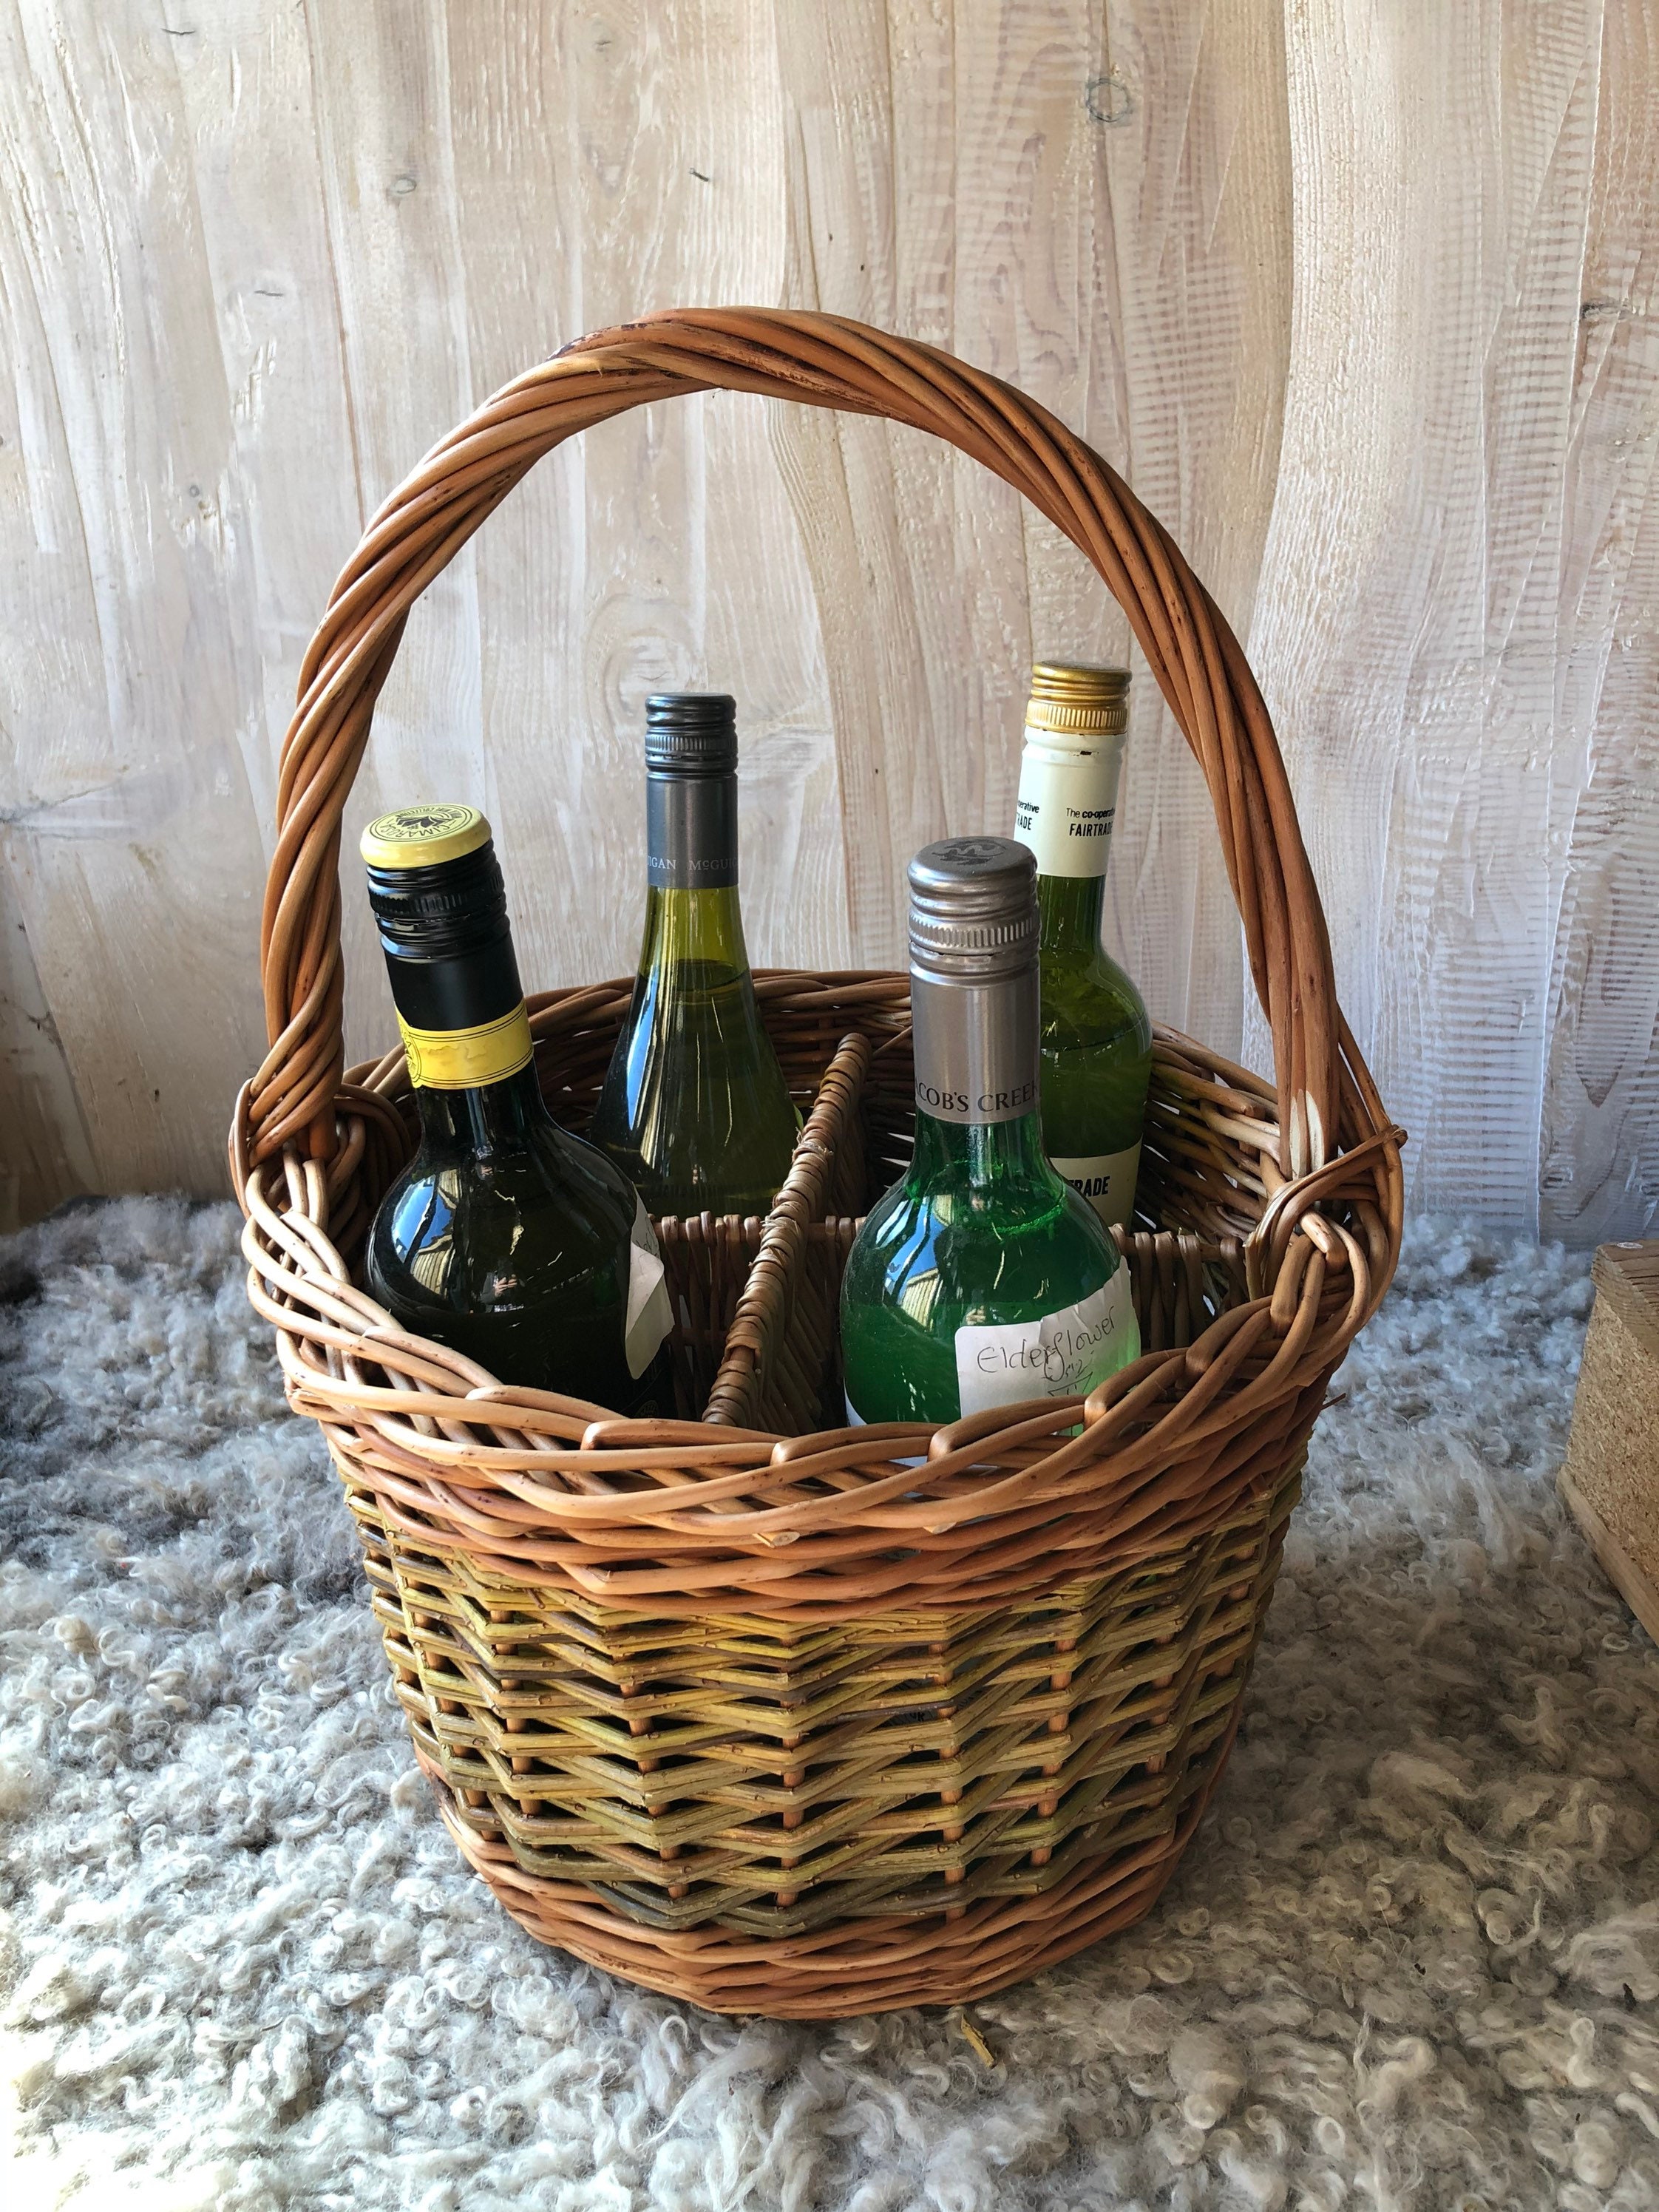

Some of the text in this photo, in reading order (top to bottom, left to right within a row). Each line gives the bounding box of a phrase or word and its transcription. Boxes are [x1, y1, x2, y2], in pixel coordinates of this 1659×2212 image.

[1066, 807, 1081, 818] The
[379, 823, 450, 838] CIMAROSA
[977, 1306, 1115, 1382] Elderflower
